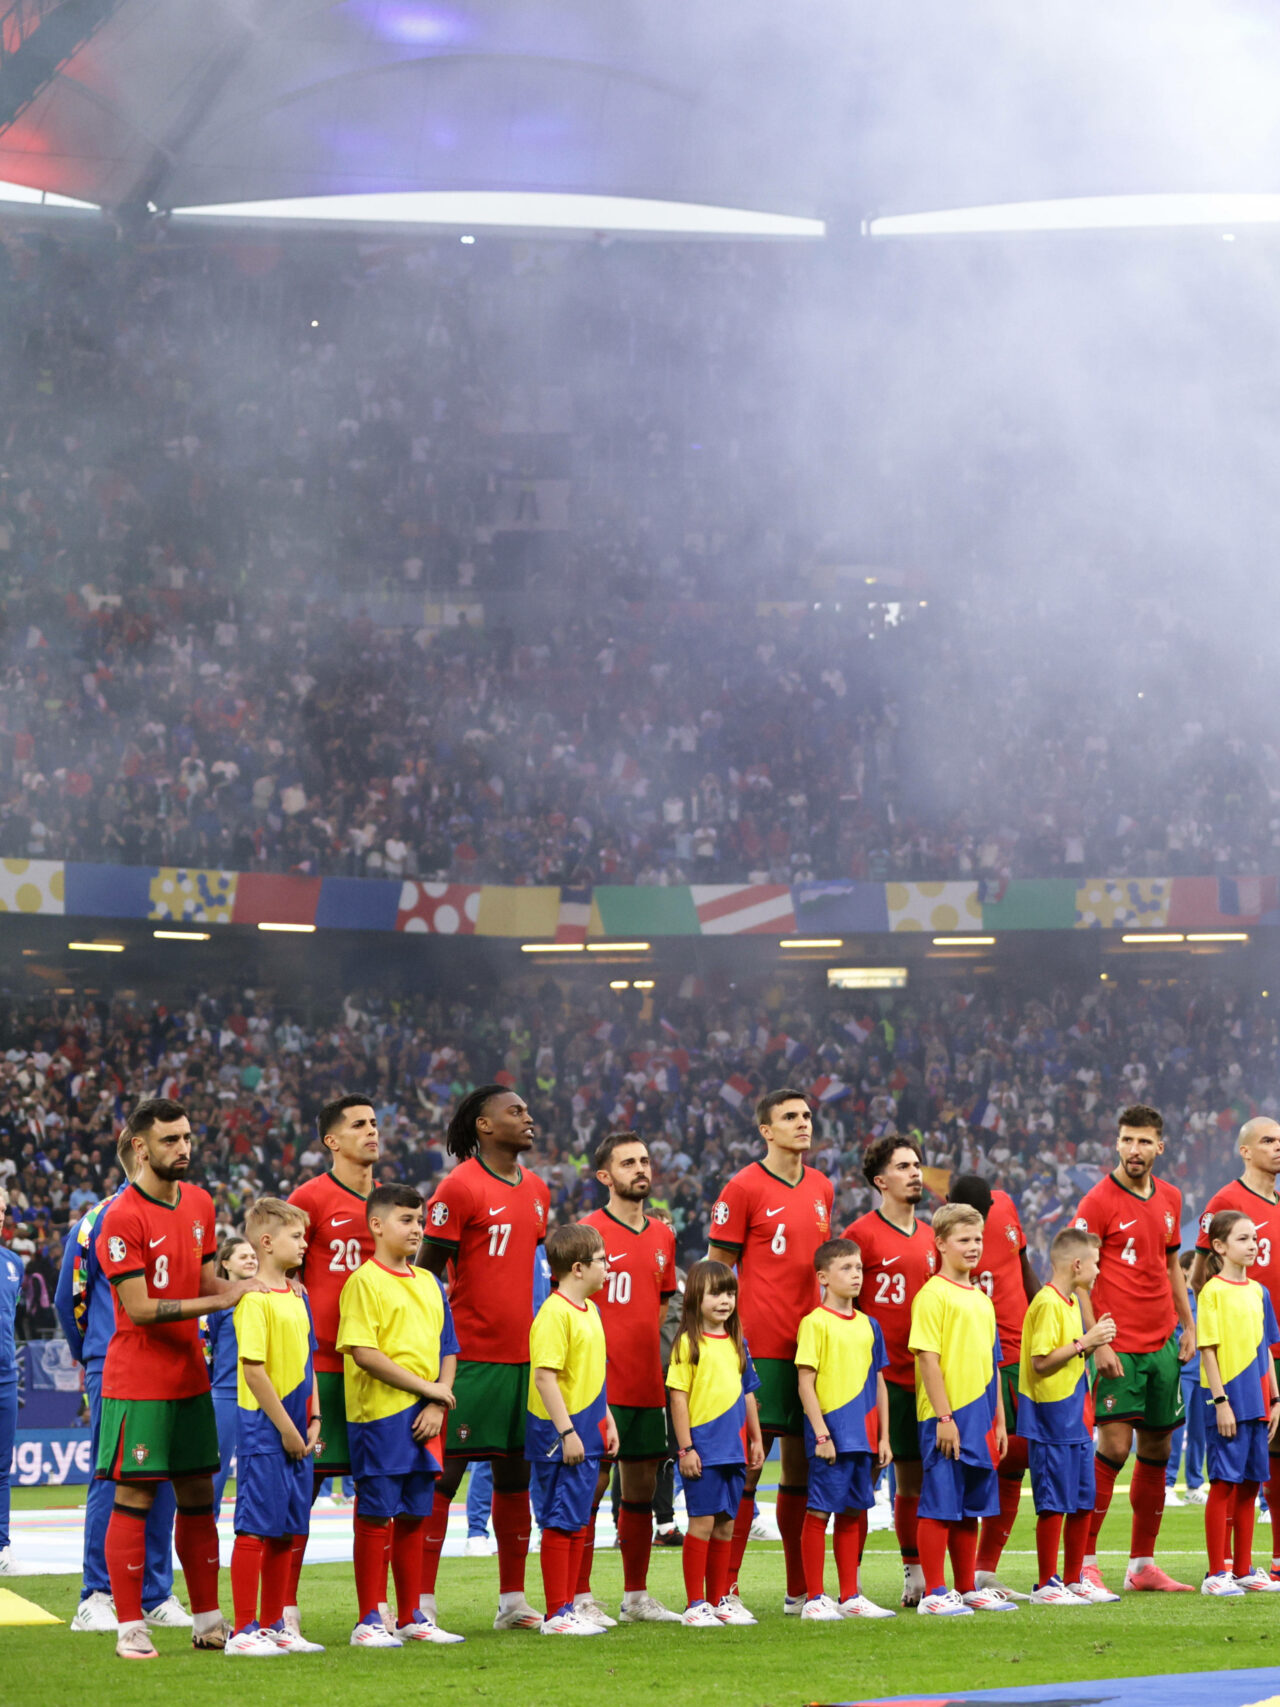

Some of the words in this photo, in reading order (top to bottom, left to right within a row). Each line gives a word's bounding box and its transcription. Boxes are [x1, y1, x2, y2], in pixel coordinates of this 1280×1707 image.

[328, 1238, 362, 1272] 20
[488, 1223, 512, 1256] 17
[771, 1223, 787, 1256] 6
[1121, 1237, 1137, 1266] 4
[153, 1254, 169, 1289] 8
[605, 1271, 632, 1304] 10
[875, 1272, 906, 1304] 23
